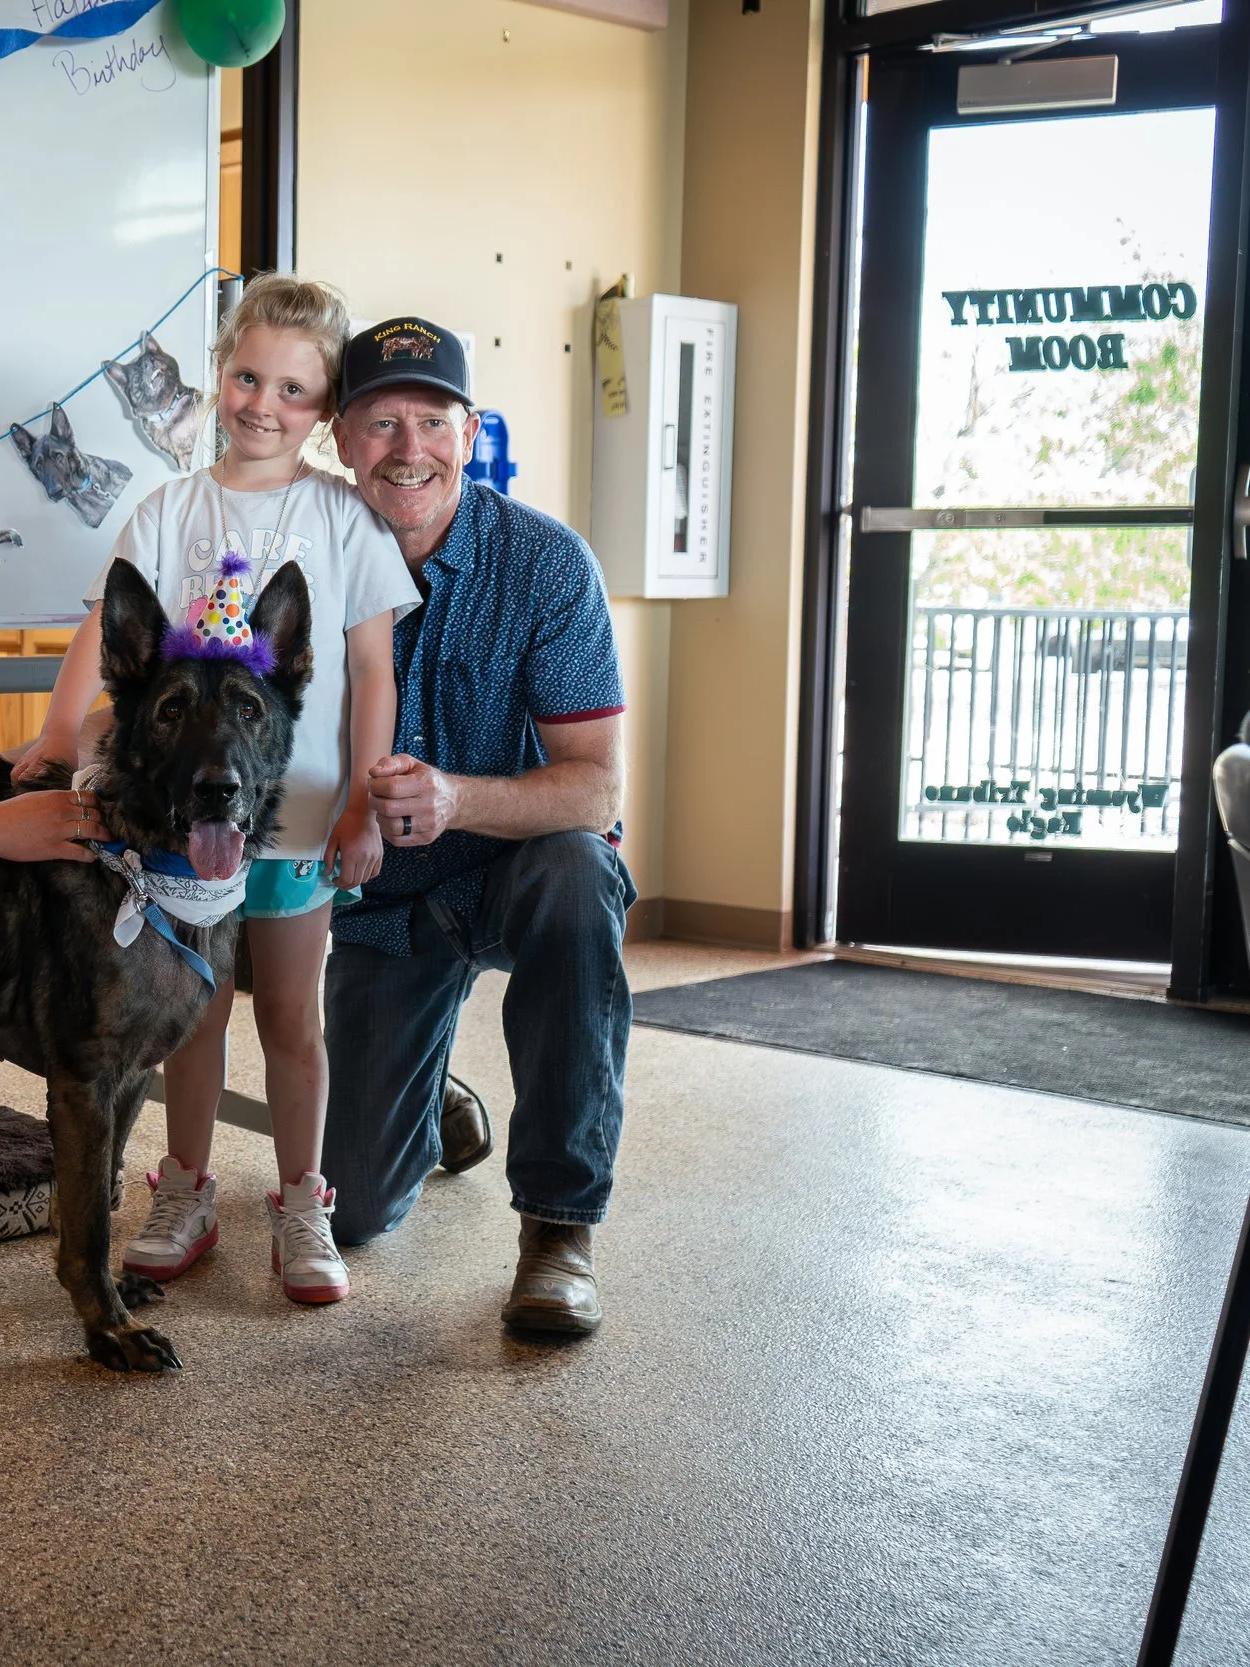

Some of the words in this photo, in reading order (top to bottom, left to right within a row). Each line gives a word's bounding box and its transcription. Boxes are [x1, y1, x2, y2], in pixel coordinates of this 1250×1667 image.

[53, 35, 176, 95] Birthday
[374, 325, 401, 341] KING
[404, 323, 441, 344] RANCH
[704, 327, 714, 377] FIRE
[698, 395, 712, 564] EXTINGUISHER
[187, 528, 313, 572] CARE
